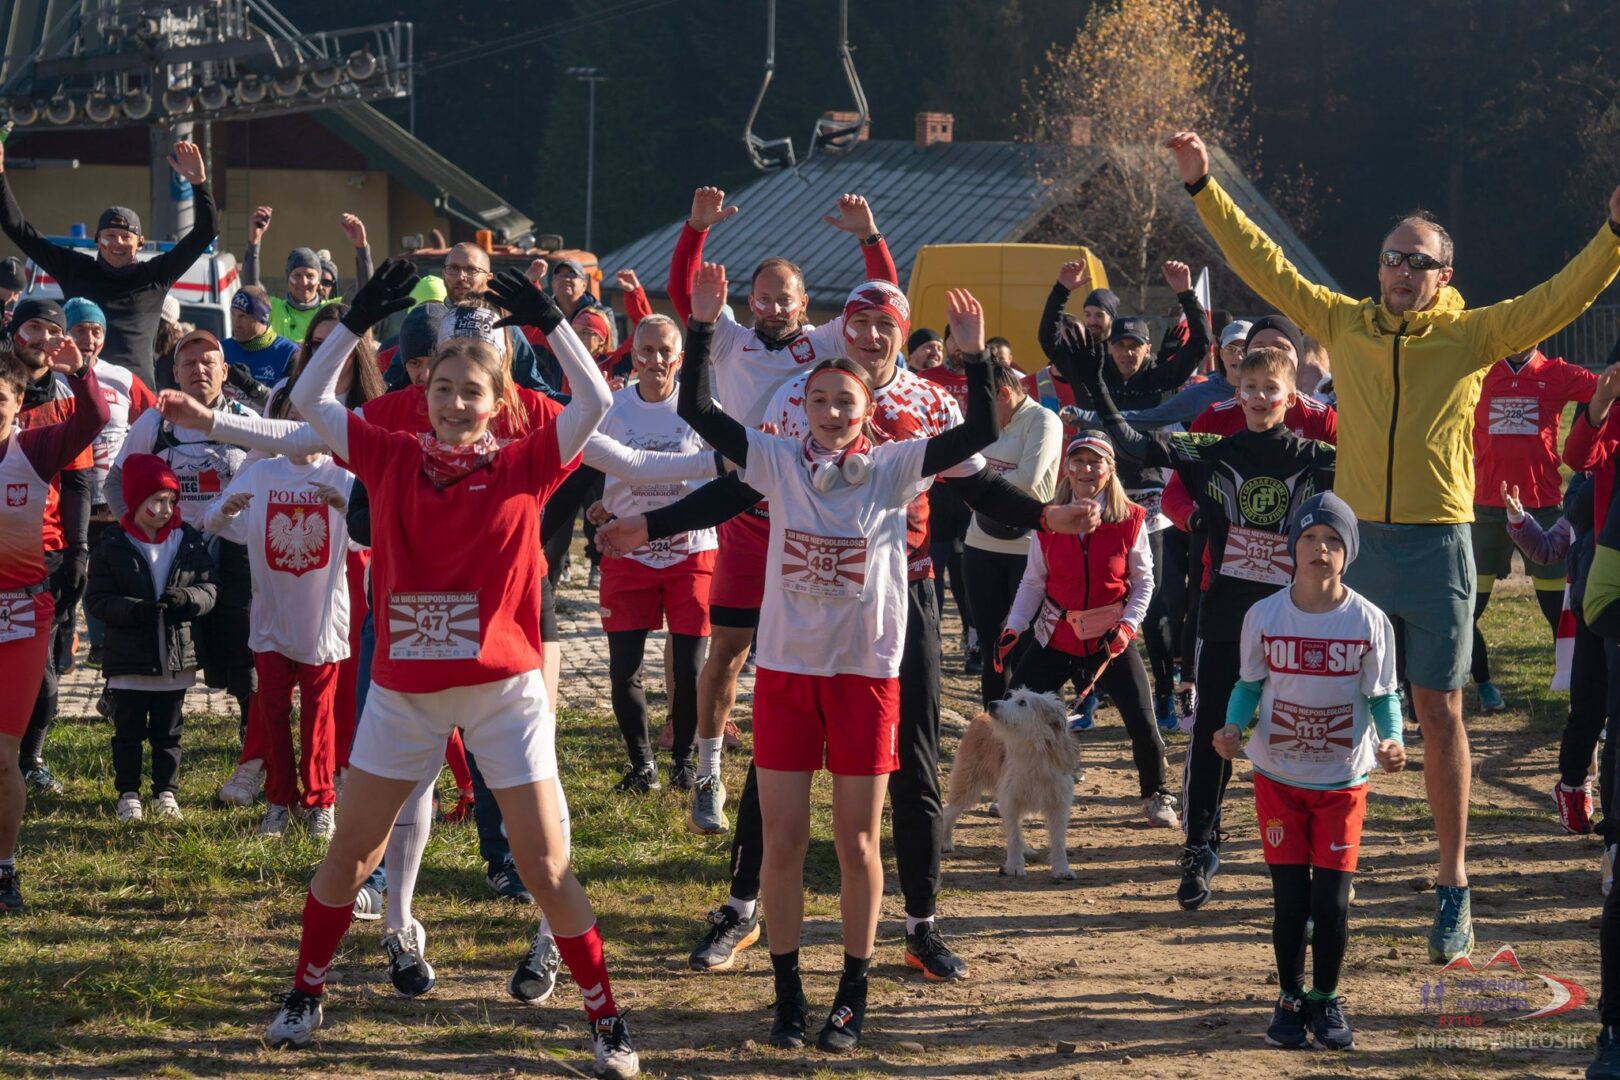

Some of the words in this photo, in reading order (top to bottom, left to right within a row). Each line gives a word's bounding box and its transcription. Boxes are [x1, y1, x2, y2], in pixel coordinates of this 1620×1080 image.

[463, 312, 489, 321] JUST
[459, 320, 490, 332] HERO
[945, 385, 969, 394] OLS
[1505, 409, 1522, 419] 228
[181, 482, 198, 493] IEG
[269, 489, 318, 504] POLSK
[796, 533, 810, 542] BIEG
[1251, 530, 1289, 542] NIEPODLEGŁO
[650, 541, 669, 552] 224
[1249, 546, 1269, 561] 131
[811, 556, 834, 571] 48
[401, 595, 416, 603] BIEG
[417, 593, 477, 603] NIEPODLEGŁOŚCI
[0, 609, 8, 623] 4
[420, 615, 444, 631] 47
[1284, 703, 1298, 713] BIEG
[1298, 704, 1352, 717] NIEPODLEGŁOŚCI
[1298, 725, 1325, 740] 113
